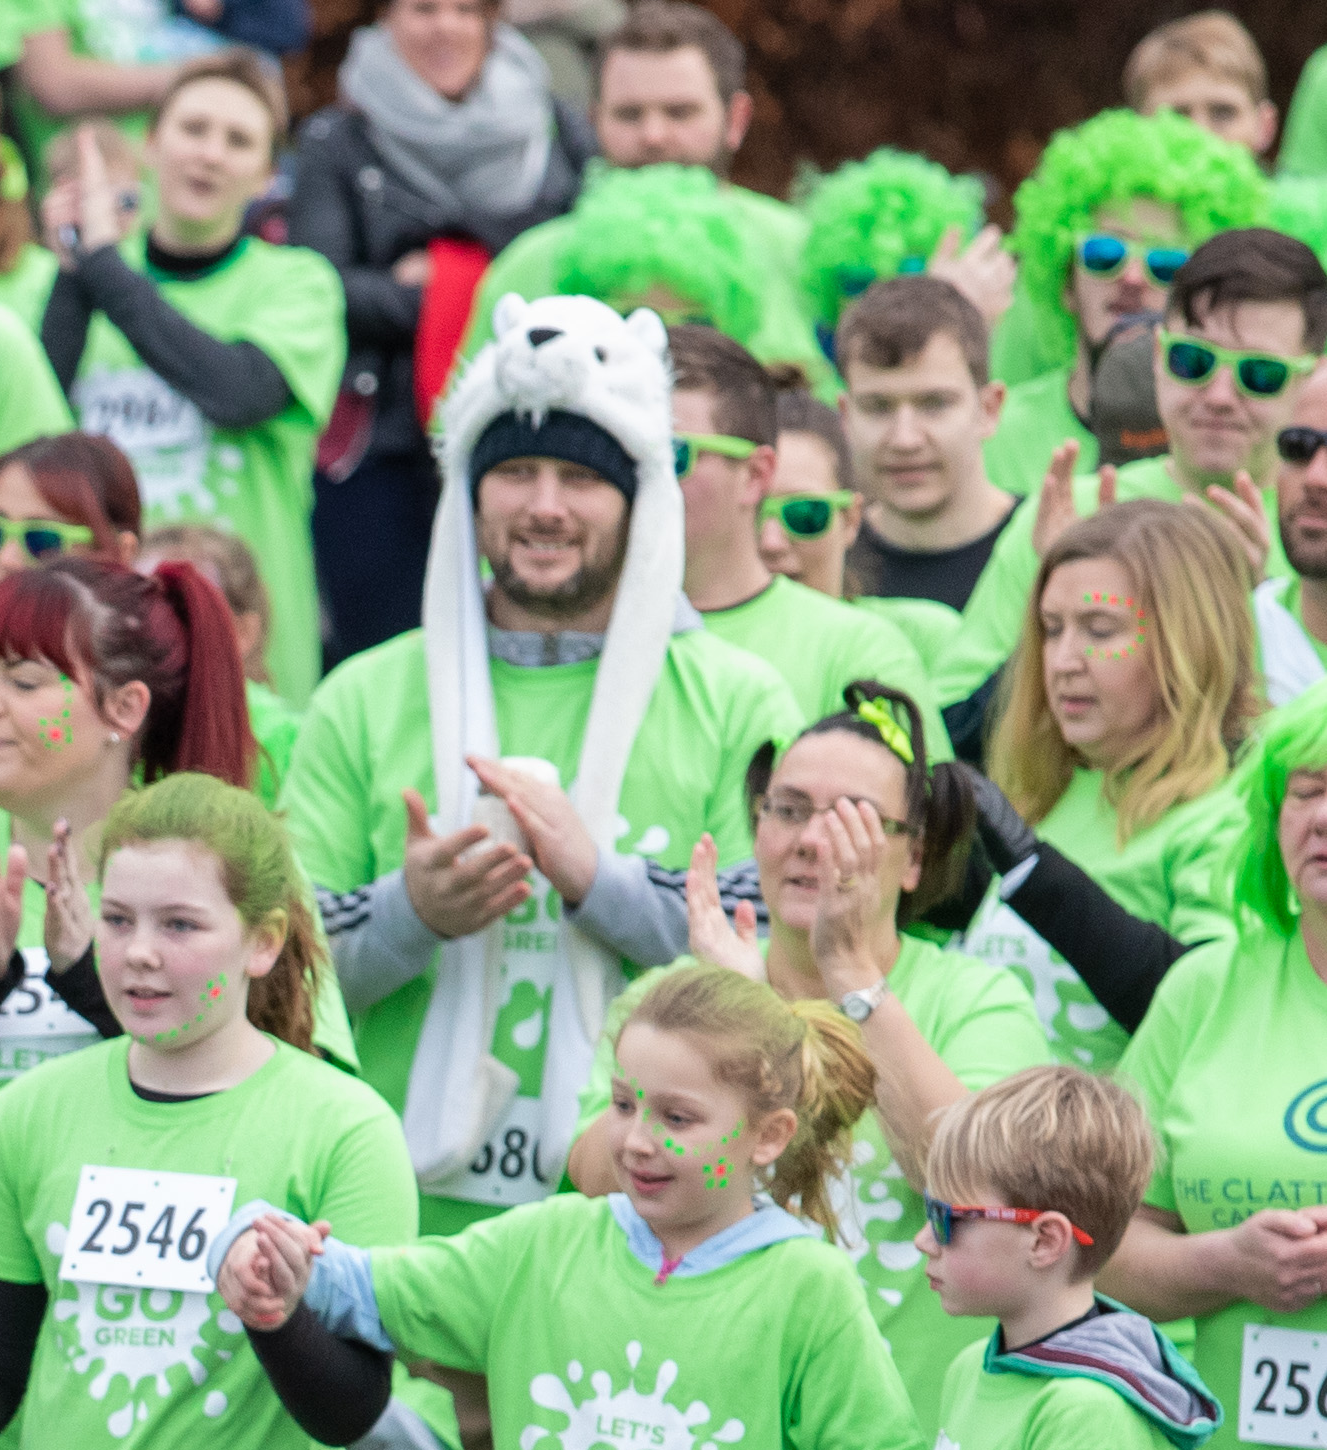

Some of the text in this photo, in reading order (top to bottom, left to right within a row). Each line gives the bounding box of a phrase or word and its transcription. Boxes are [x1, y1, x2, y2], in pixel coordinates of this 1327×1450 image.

[79, 1198, 207, 1262] 2546
[95, 1283, 184, 1322] GO
[95, 1327, 176, 1347] GREEN
[596, 1414, 666, 1445] LET'S
